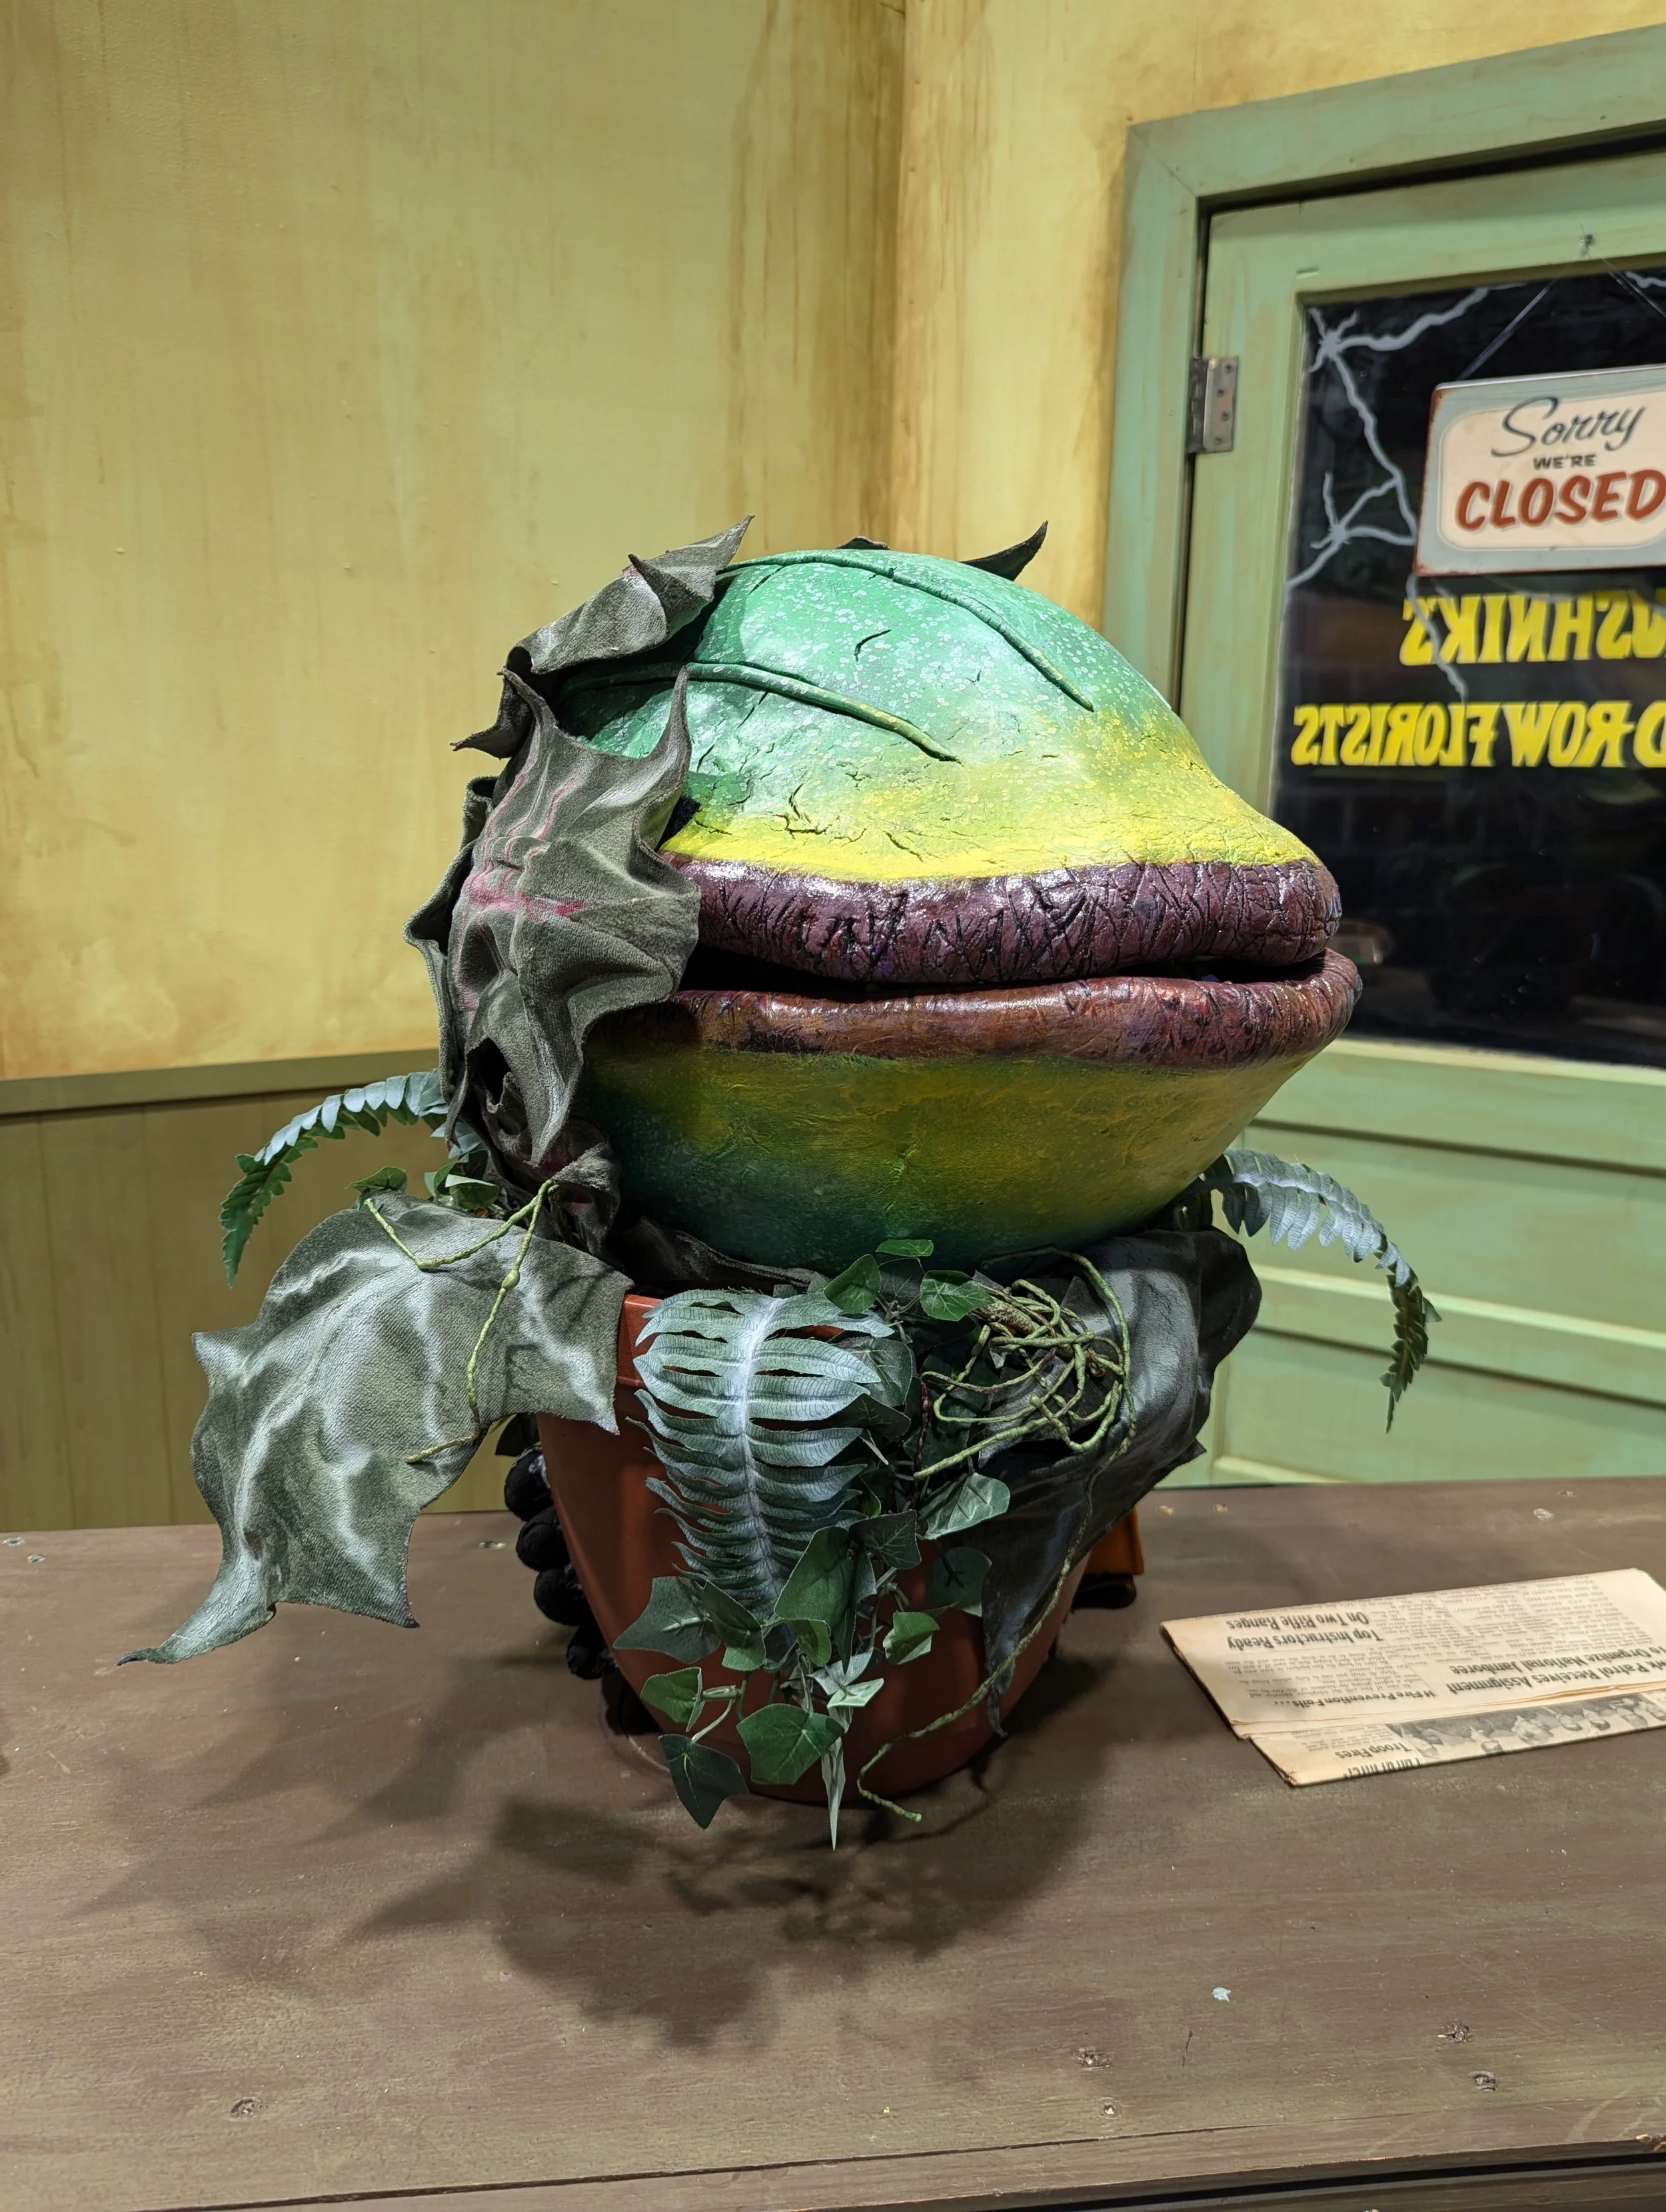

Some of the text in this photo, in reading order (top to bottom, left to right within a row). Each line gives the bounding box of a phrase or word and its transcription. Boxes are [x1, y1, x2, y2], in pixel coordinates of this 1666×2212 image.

[1490, 396, 1646, 458] Sorry
[1533, 454, 1597, 470] WE'RE
[1455, 469, 1666, 532] CLOSED
[1226, 1612, 1369, 1631] On Two Rifle Ranges
[1226, 1628, 1383, 1651] Top Instructors Ready
[1519, 1655, 1589, 1671] National
[1583, 1648, 1651, 1662] Organize
[1449, 1660, 1523, 1675] Jamboree
[1597, 1662, 1650, 1679] Patrol
[1531, 1669, 1601, 1684] Receives
[1445, 1677, 1533, 1695] Assignment
[1323, 1692, 1396, 1704] Prevention
[1334, 1742, 1412, 1760] Troop Fires
